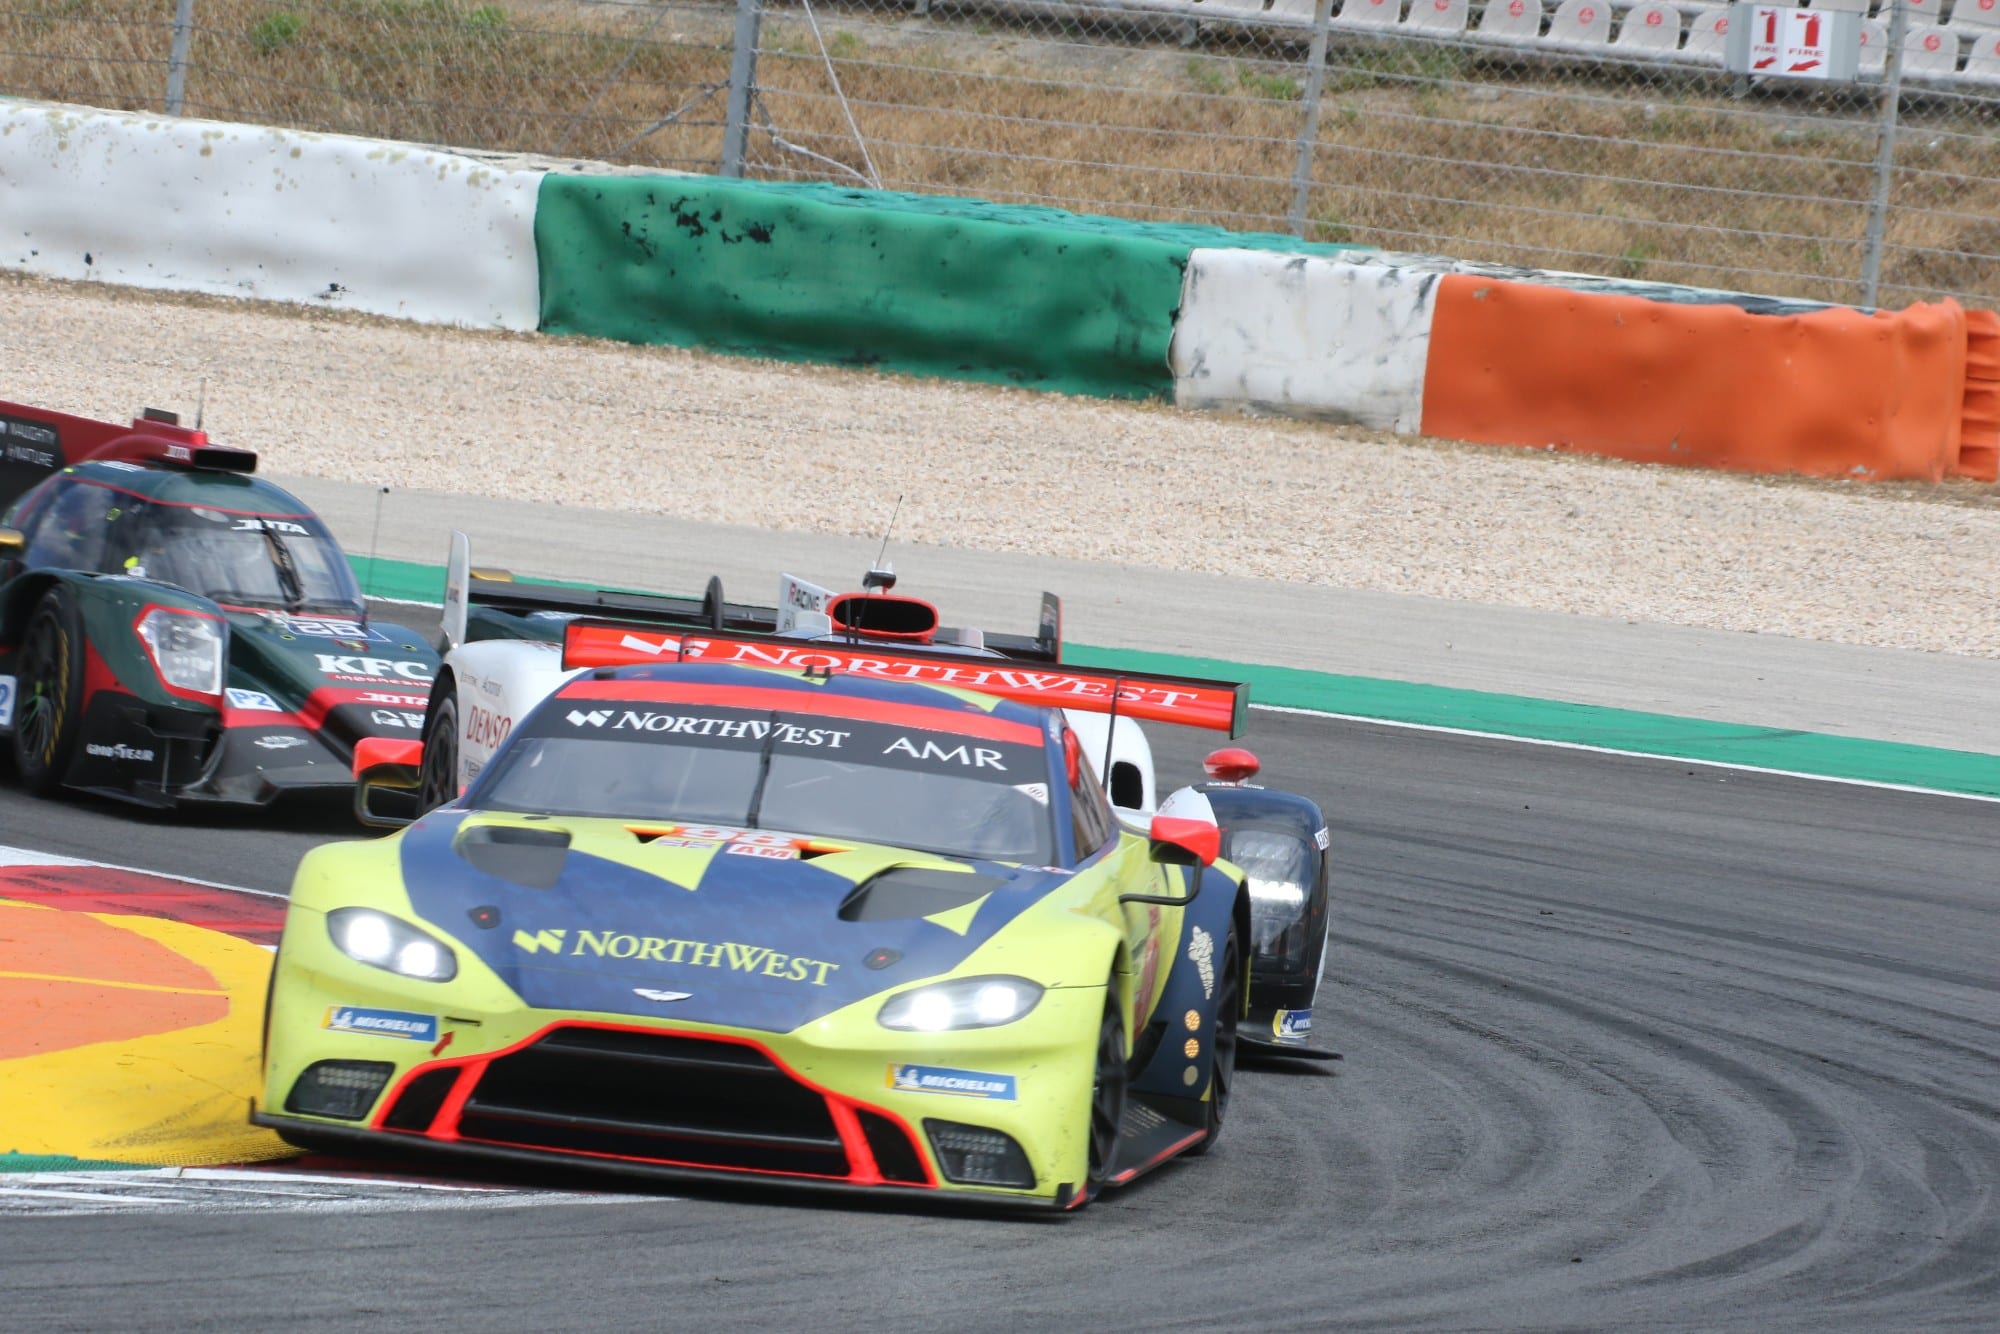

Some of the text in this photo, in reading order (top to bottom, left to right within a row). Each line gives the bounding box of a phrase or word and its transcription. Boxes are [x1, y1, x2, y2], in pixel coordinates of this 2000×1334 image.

[1788, 47, 1824, 57] FIRE
[314, 653, 434, 681] KFC
[733, 644, 1199, 709] NORTHWEST
[230, 690, 273, 707] P2
[467, 704, 512, 750] DENSO
[612, 710, 1007, 771] NORTHWEST AMR
[86, 743, 154, 761] GOODYEAR
[737, 845, 788, 859] AM
[570, 929, 840, 986] NORTHWEST
[352, 1016, 430, 1033] MICHELIN
[921, 1075, 1007, 1092] MICHELIN
